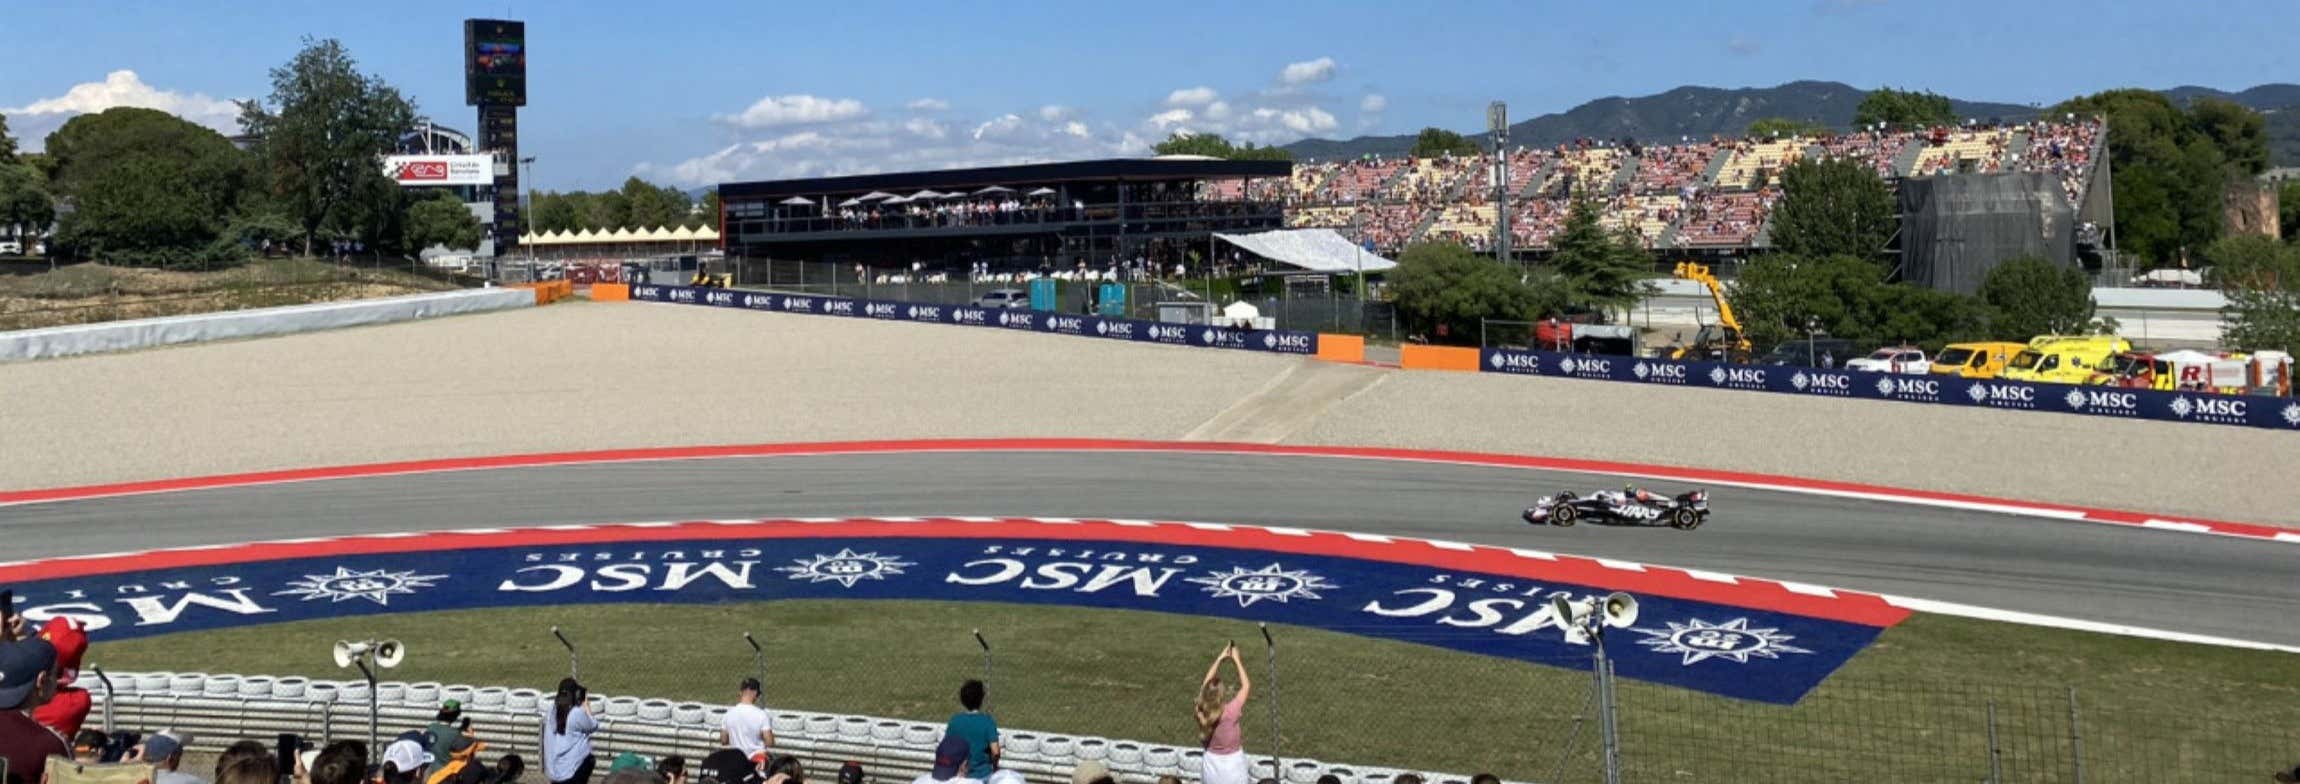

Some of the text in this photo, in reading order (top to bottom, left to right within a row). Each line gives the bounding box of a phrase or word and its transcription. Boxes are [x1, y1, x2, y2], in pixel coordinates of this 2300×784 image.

[832, 301, 854, 312] MSC
[875, 304, 896, 314] MSC
[919, 307, 940, 317] MSC
[964, 310, 985, 320] MSC
[1009, 312, 1033, 324] MSC
[1059, 318, 1082, 330] MSC
[1108, 322, 1132, 334] MSC
[1160, 326, 1186, 338] MSC
[1216, 330, 1244, 343] MSC
[1278, 334, 1309, 347] MSC
[1506, 354, 1539, 368] MSC
[1577, 358, 1611, 373] MSC
[1650, 363, 1686, 378] MSC
[1728, 368, 1766, 383] MSC
[1810, 373, 1850, 388] MSC
[1897, 378, 1939, 394] MSC
[1990, 384, 2035, 401] MSC
[2089, 391, 2137, 408] MSC
[2195, 399, 2247, 416] MSC
[525, 549, 762, 562] CRUISES
[983, 545, 1199, 564] CRUISES
[498, 561, 761, 592] MSC
[945, 559, 1186, 597] MSC
[22, 587, 278, 632] MS
